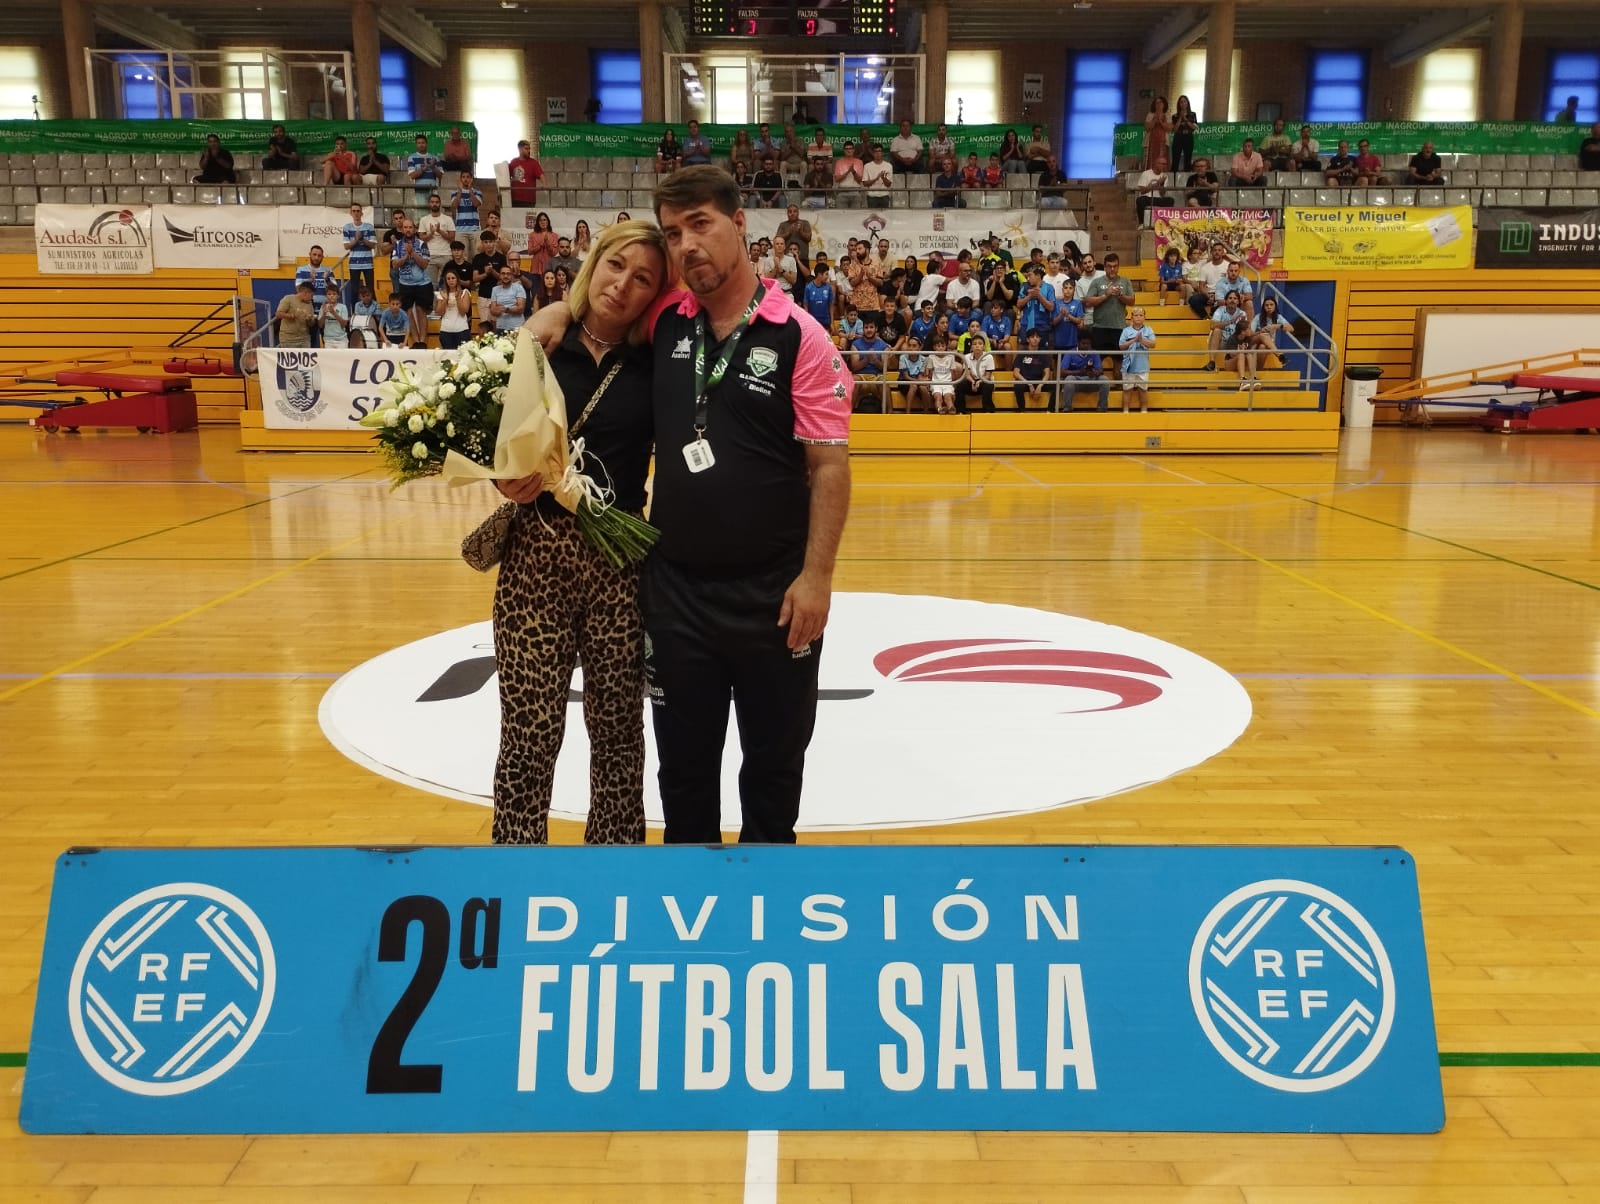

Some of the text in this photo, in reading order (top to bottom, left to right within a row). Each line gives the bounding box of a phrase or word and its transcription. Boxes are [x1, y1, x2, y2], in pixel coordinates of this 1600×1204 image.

[738, 9, 759, 18] FALTAS
[798, 9, 818, 18] FALTAS
[1240, 124, 1273, 133] INAGRO
[1337, 121, 1382, 130] INAGROUP
[1386, 121, 1431, 130] INAGROUP
[1157, 209, 1180, 219] CLUB
[1182, 209, 1228, 219] GIMNASIA
[1295, 210, 1407, 224] Teruel y Miguel
[40, 229, 101, 244] Audasa
[193, 225, 254, 244] fircosa
[1539, 223, 1600, 241] INDU
[47, 250, 96, 259] SUMINISTROS
[1538, 244, 1578, 252] INGENUITY
[1581, 244, 1595, 252] FOR
[276, 351, 319, 368] INDIOS
[524, 878, 1080, 943] DIVISIÓN
[516, 941, 1098, 1094] FÚTBOL SALA
